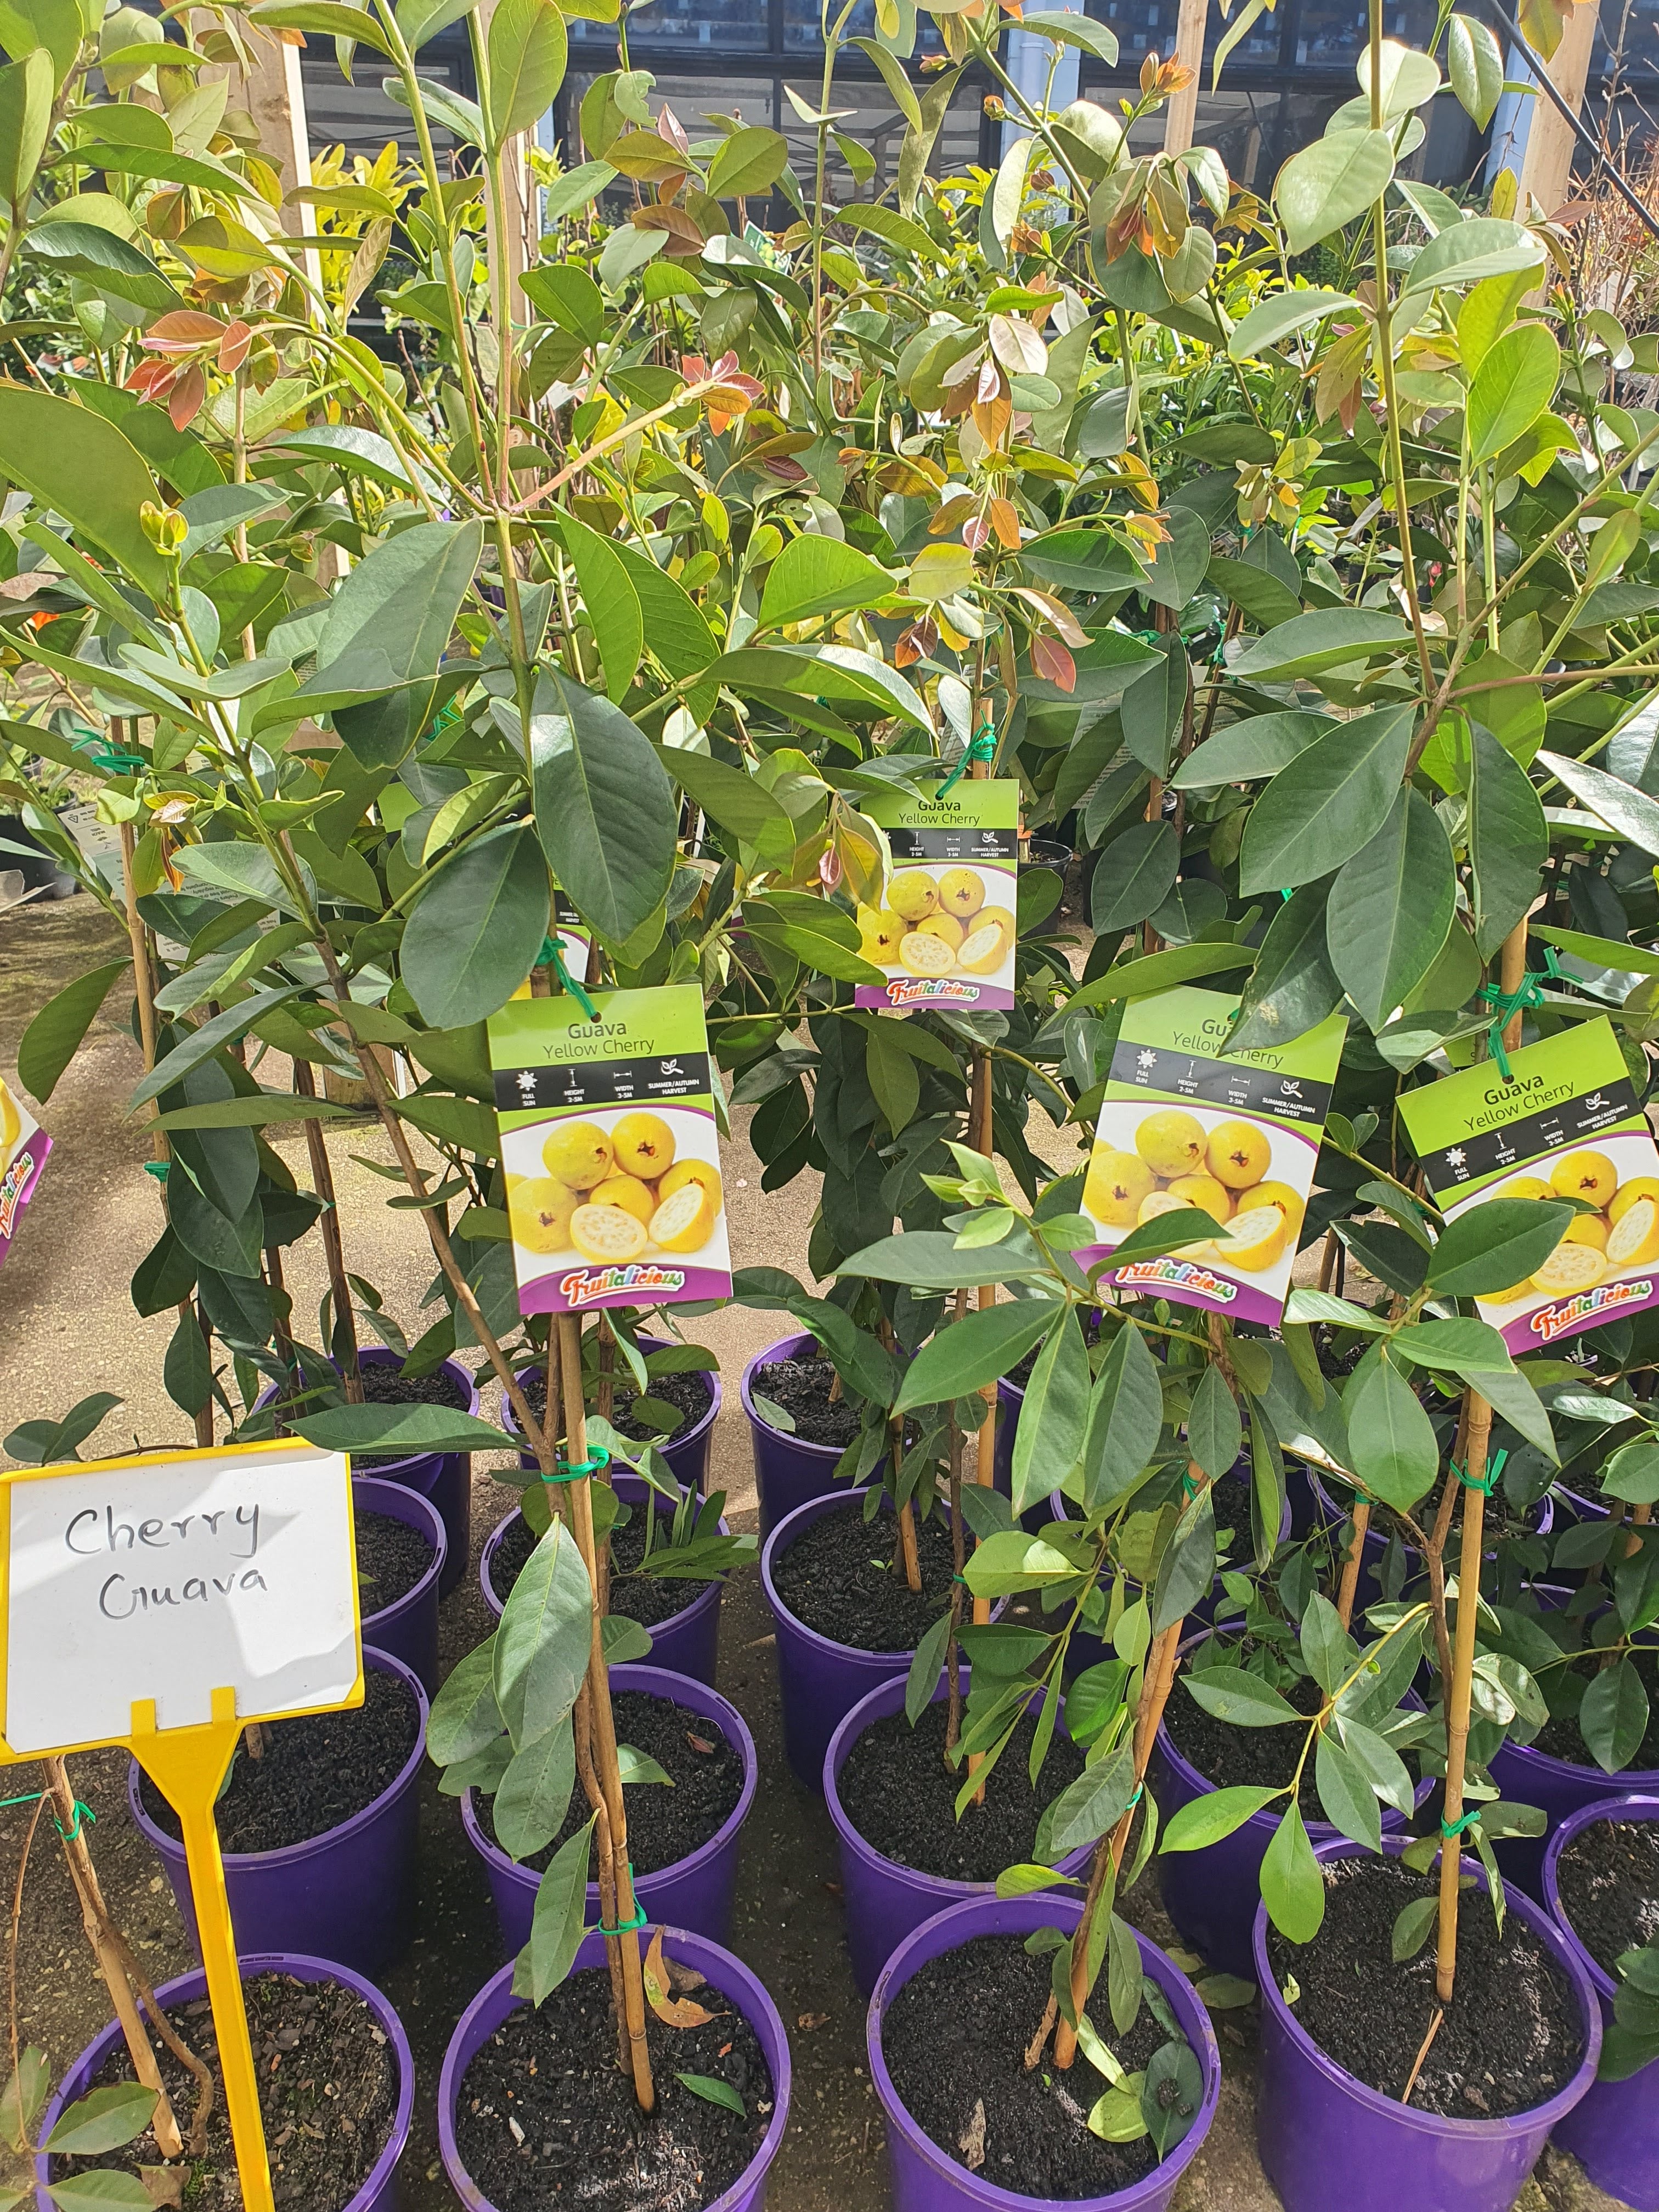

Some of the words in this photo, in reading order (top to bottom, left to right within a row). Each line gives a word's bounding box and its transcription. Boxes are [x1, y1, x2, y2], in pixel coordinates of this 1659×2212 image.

[918, 800, 961, 811] Guava
[899, 813, 938, 824] Yellow
[941, 813, 980, 827] Cherry
[888, 979, 978, 1003] Fruitalicious
[568, 1023, 627, 1039] Guava
[543, 1043, 598, 1059] Yellow
[603, 1039, 655, 1054] Cherry
[1172, 1031, 1222, 1053] Yellow
[648, 1079, 699, 1090] SUMMER/AUTUMN
[1177, 1079, 1199, 1088] HEIGHT
[1179, 1086, 1194, 1094] 2-5M
[1484, 1074, 1544, 1105] Guava
[662, 1087, 687, 1096] HARVEST
[1228, 1090, 1248, 1099] WIDTH
[1228, 1097, 1244, 1105] 3-5M
[1262, 1097, 1316, 1114] SUMMER/AUTUMN
[1463, 1103, 1520, 1132] Yellow
[1523, 1081, 1575, 1109] Cherry
[1273, 1107, 1301, 1118] HARVEST
[1577, 1104, 1628, 1129] SUMMER/AUTUMN
[1591, 1115, 1617, 1130] HARVEST
[1544, 1130, 1564, 1142] WIDTH
[1495, 1148, 1516, 1161] HEIGHT
[1454, 1166, 1468, 1176] FULL
[1457, 1172, 1470, 1182] SUN
[562, 1266, 683, 1305] Fruitalicious
[1533, 1281, 1651, 1339] Fruitalicious
[65, 1503, 260, 1559] Cherry
[98, 1568, 268, 1621] Guava
